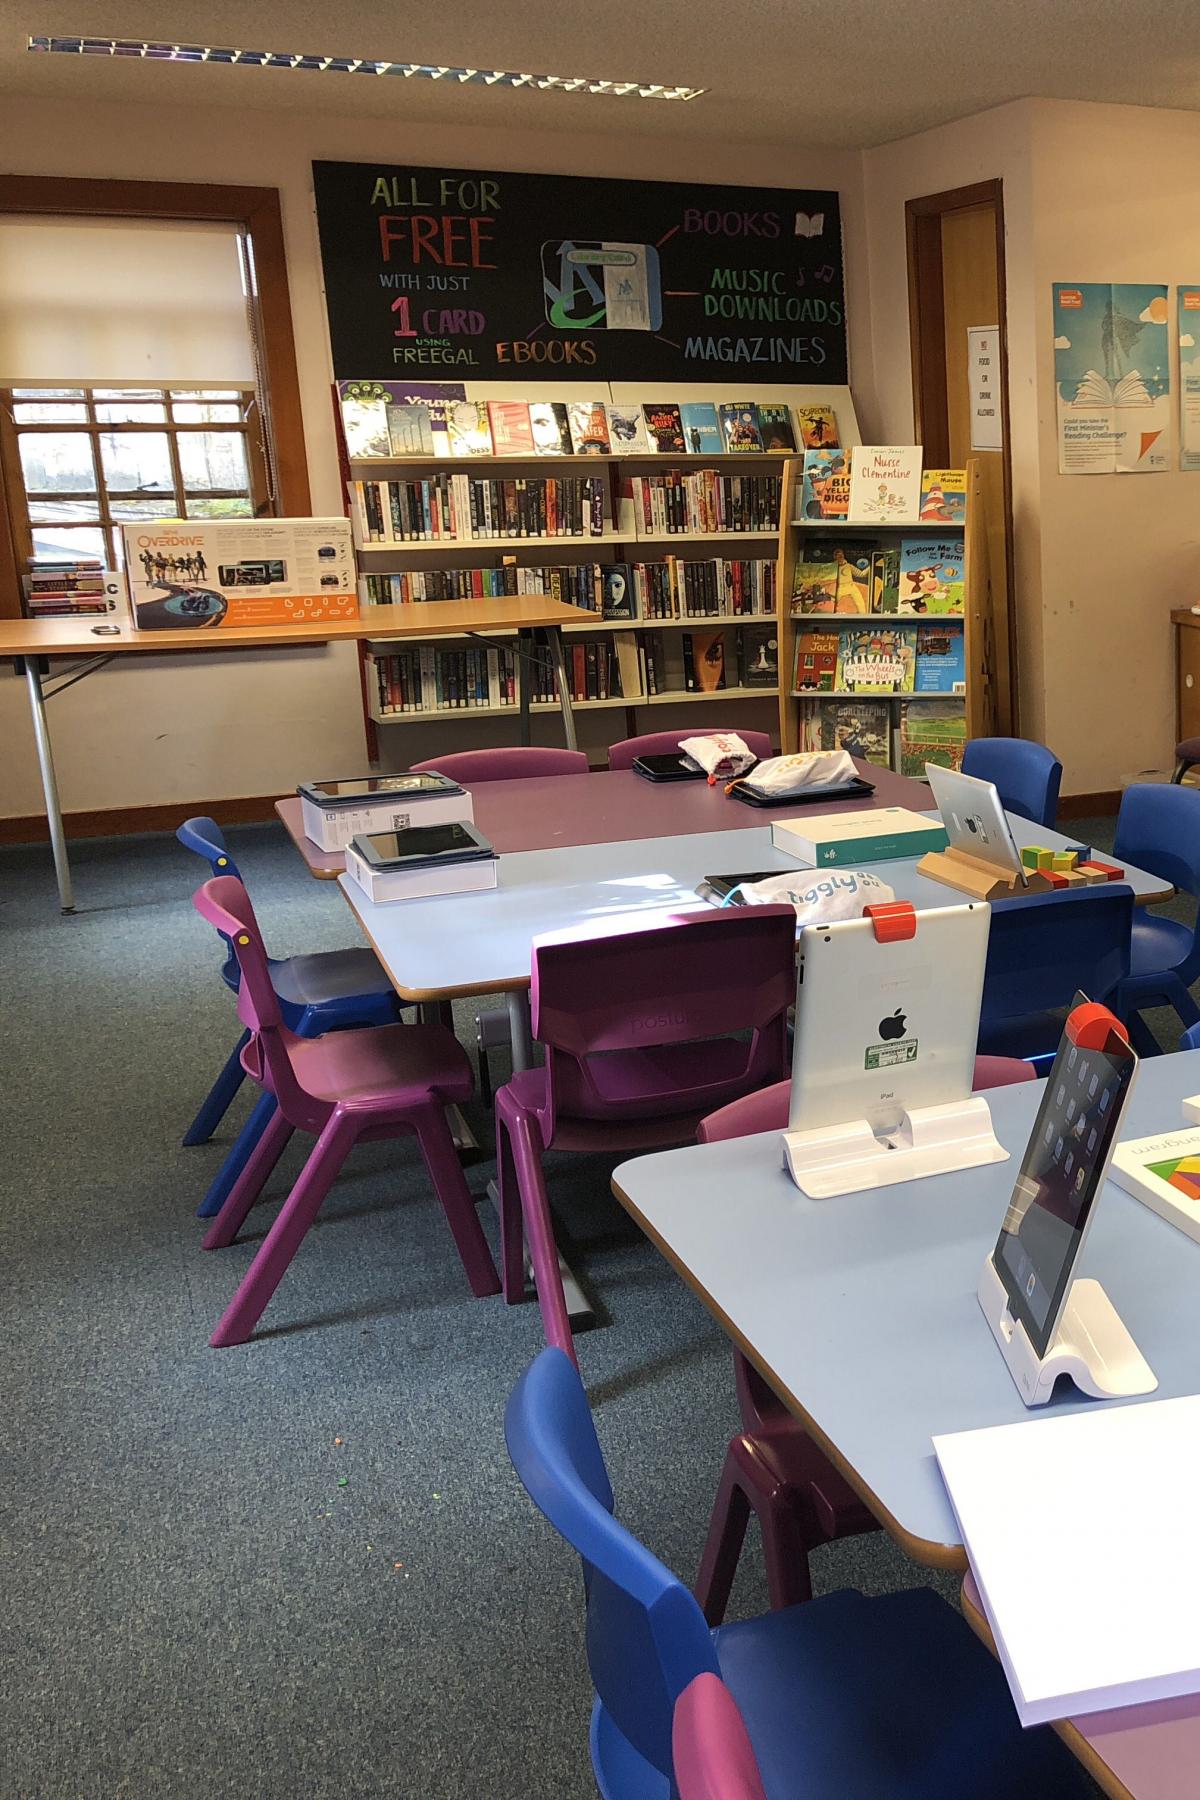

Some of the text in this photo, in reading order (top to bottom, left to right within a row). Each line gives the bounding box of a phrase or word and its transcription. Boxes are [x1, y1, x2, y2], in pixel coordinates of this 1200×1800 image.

[370, 177, 500, 212] ALL FOR
[683, 209, 781, 238] BOOKS
[379, 215, 498, 269] FREE
[379, 273, 471, 291] WITH JUST
[711, 268, 787, 295] MUSIC
[704, 294, 842, 326] DOWNLOADS
[391, 296, 486, 337] 1 CARD
[415, 338, 451, 346] USING
[393, 348, 480, 365] FREEGAL
[495, 340, 597, 365] EBOOKS
[684, 337, 827, 365] MAGAZINES
[1063, 424, 1079, 432] First
[1063, 432, 1091, 440] Reading
[873, 455, 901, 468] Nurse
[862, 468, 911, 478] Clementine
[825, 487, 851, 495] YELL
[823, 494, 850, 503] DIGG
[138, 535, 204, 548] OVERDRIVE
[905, 545, 935, 557] Follow
[939, 551, 963, 561] Farm
[812, 633, 825, 641] The
[809, 641, 835, 652] Jack
[866, 663, 897, 673] Wheels
[875, 671, 890, 680] Bus
[880, 1091, 894, 1100] iPad
